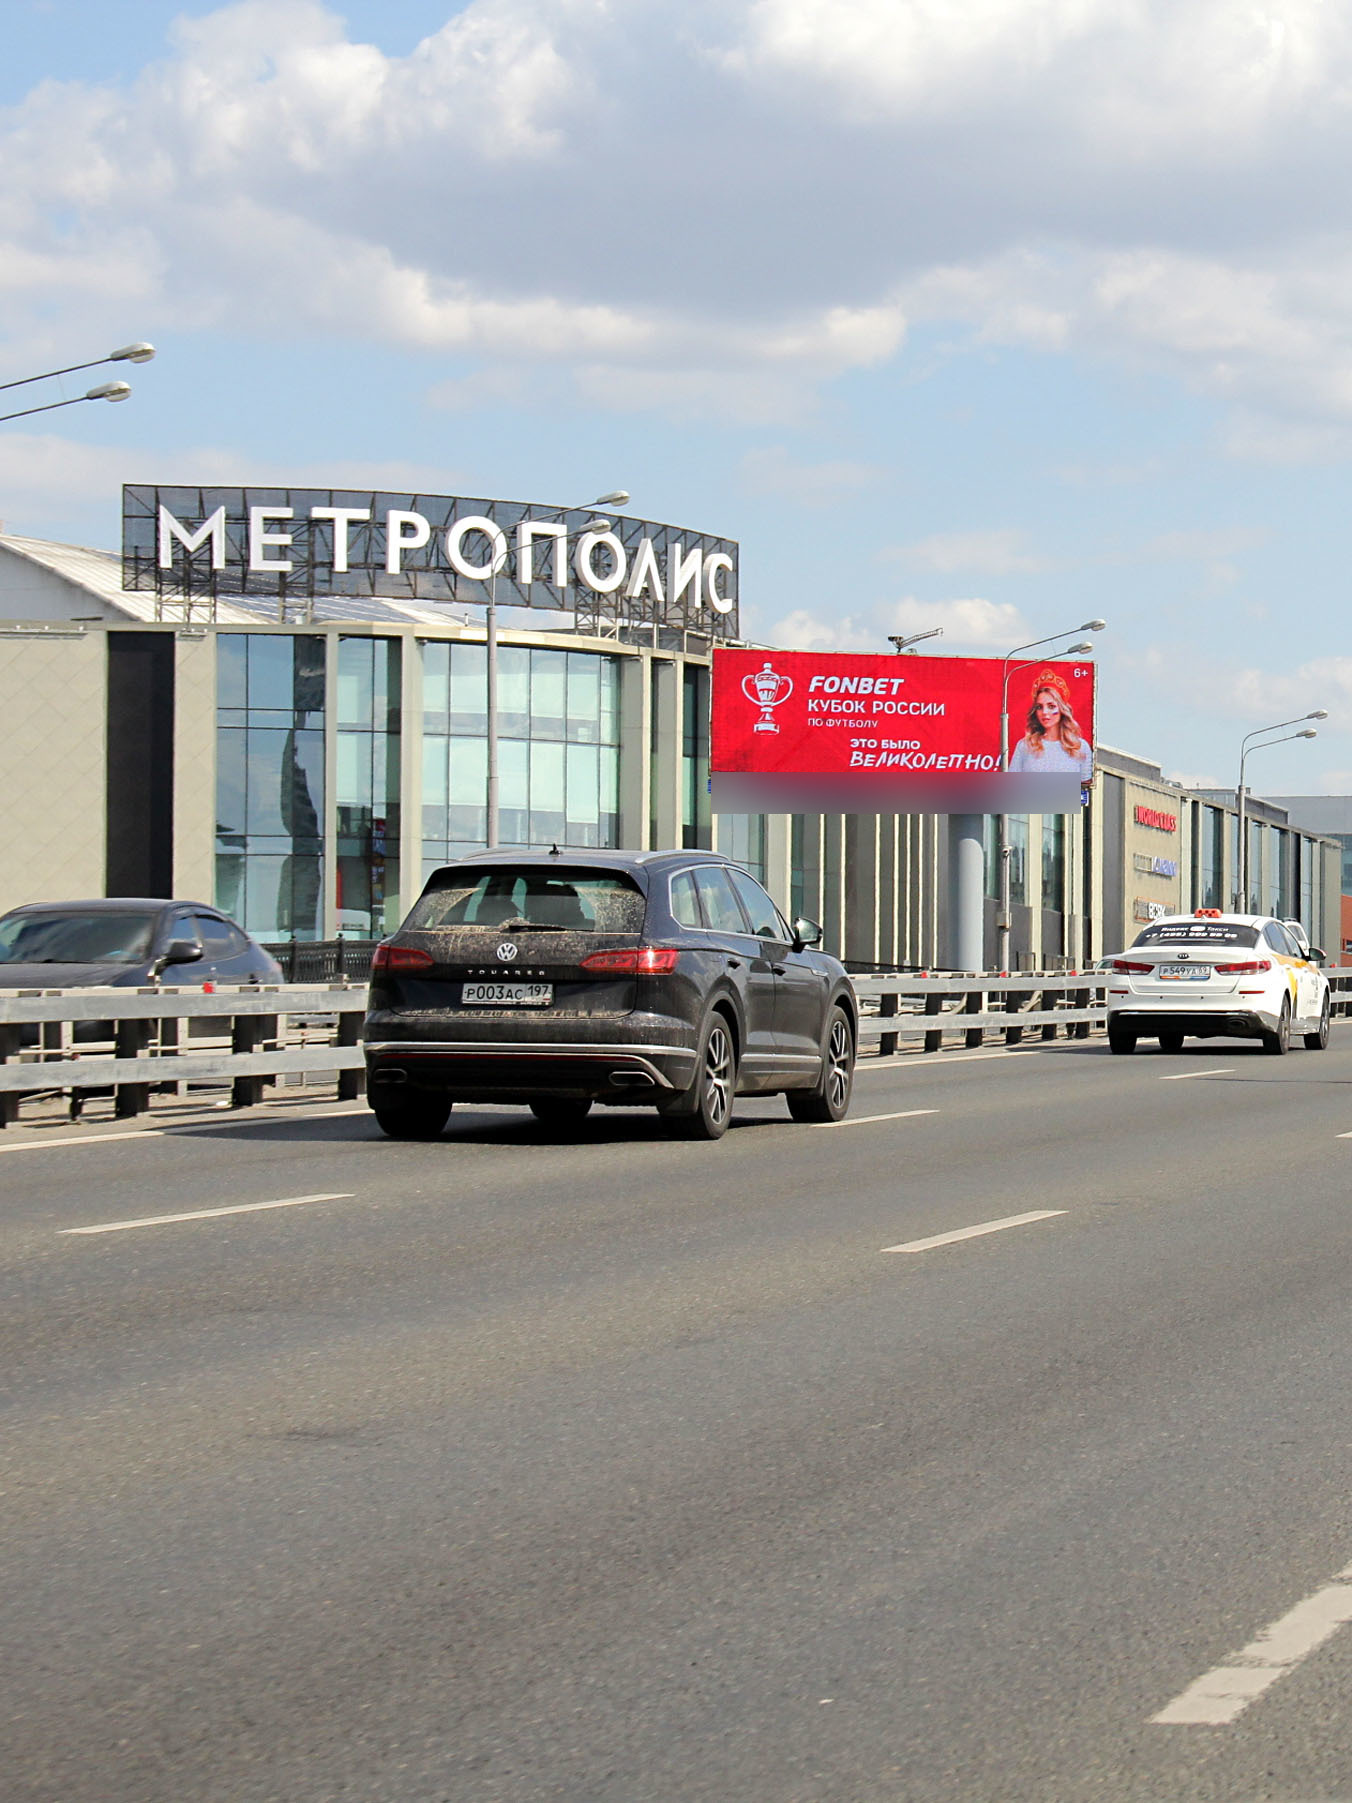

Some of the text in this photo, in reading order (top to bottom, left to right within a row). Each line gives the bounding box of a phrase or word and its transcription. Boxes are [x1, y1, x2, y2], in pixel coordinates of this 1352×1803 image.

[158, 503, 734, 615] МЕТРОПОЛИС
[1073, 667, 1089, 678] 6+
[808, 675, 905, 696] FONBET
[807, 699, 945, 716] КУБОК РОССИИ
[807, 718, 879, 729] ПО ФУТБОЛУ
[850, 738, 921, 750] ЭТО БЫЛО
[849, 750, 1002, 772] ВЕЛИКОЛЕПНО!
[527, 985, 549, 997] 197
